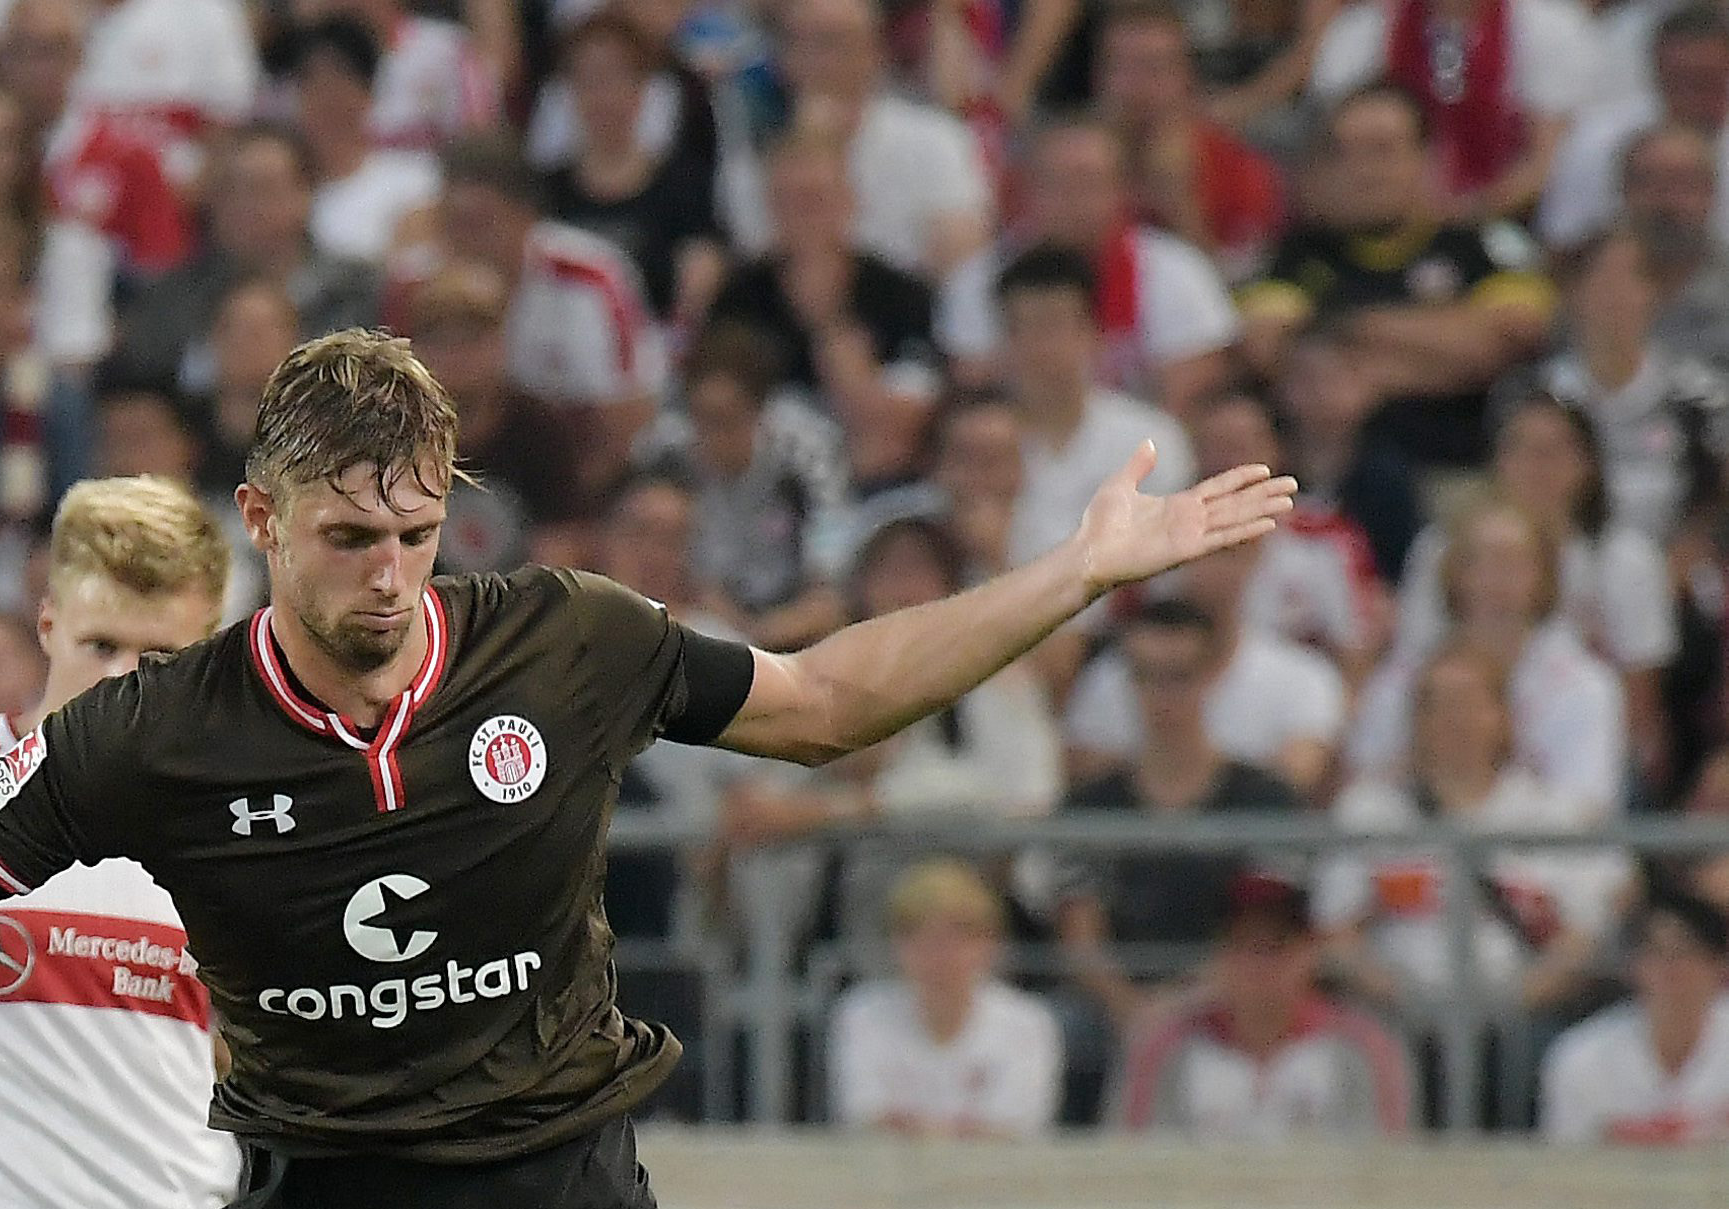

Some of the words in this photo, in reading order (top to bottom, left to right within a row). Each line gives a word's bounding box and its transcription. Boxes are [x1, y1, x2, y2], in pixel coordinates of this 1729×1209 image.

[477, 727, 496, 745] ST.
[497, 719, 540, 748] PAULI
[472, 749, 483, 767] FC
[502, 782, 532, 800] 1910
[112, 966, 175, 1003] Bank
[258, 951, 542, 1029] congstar
